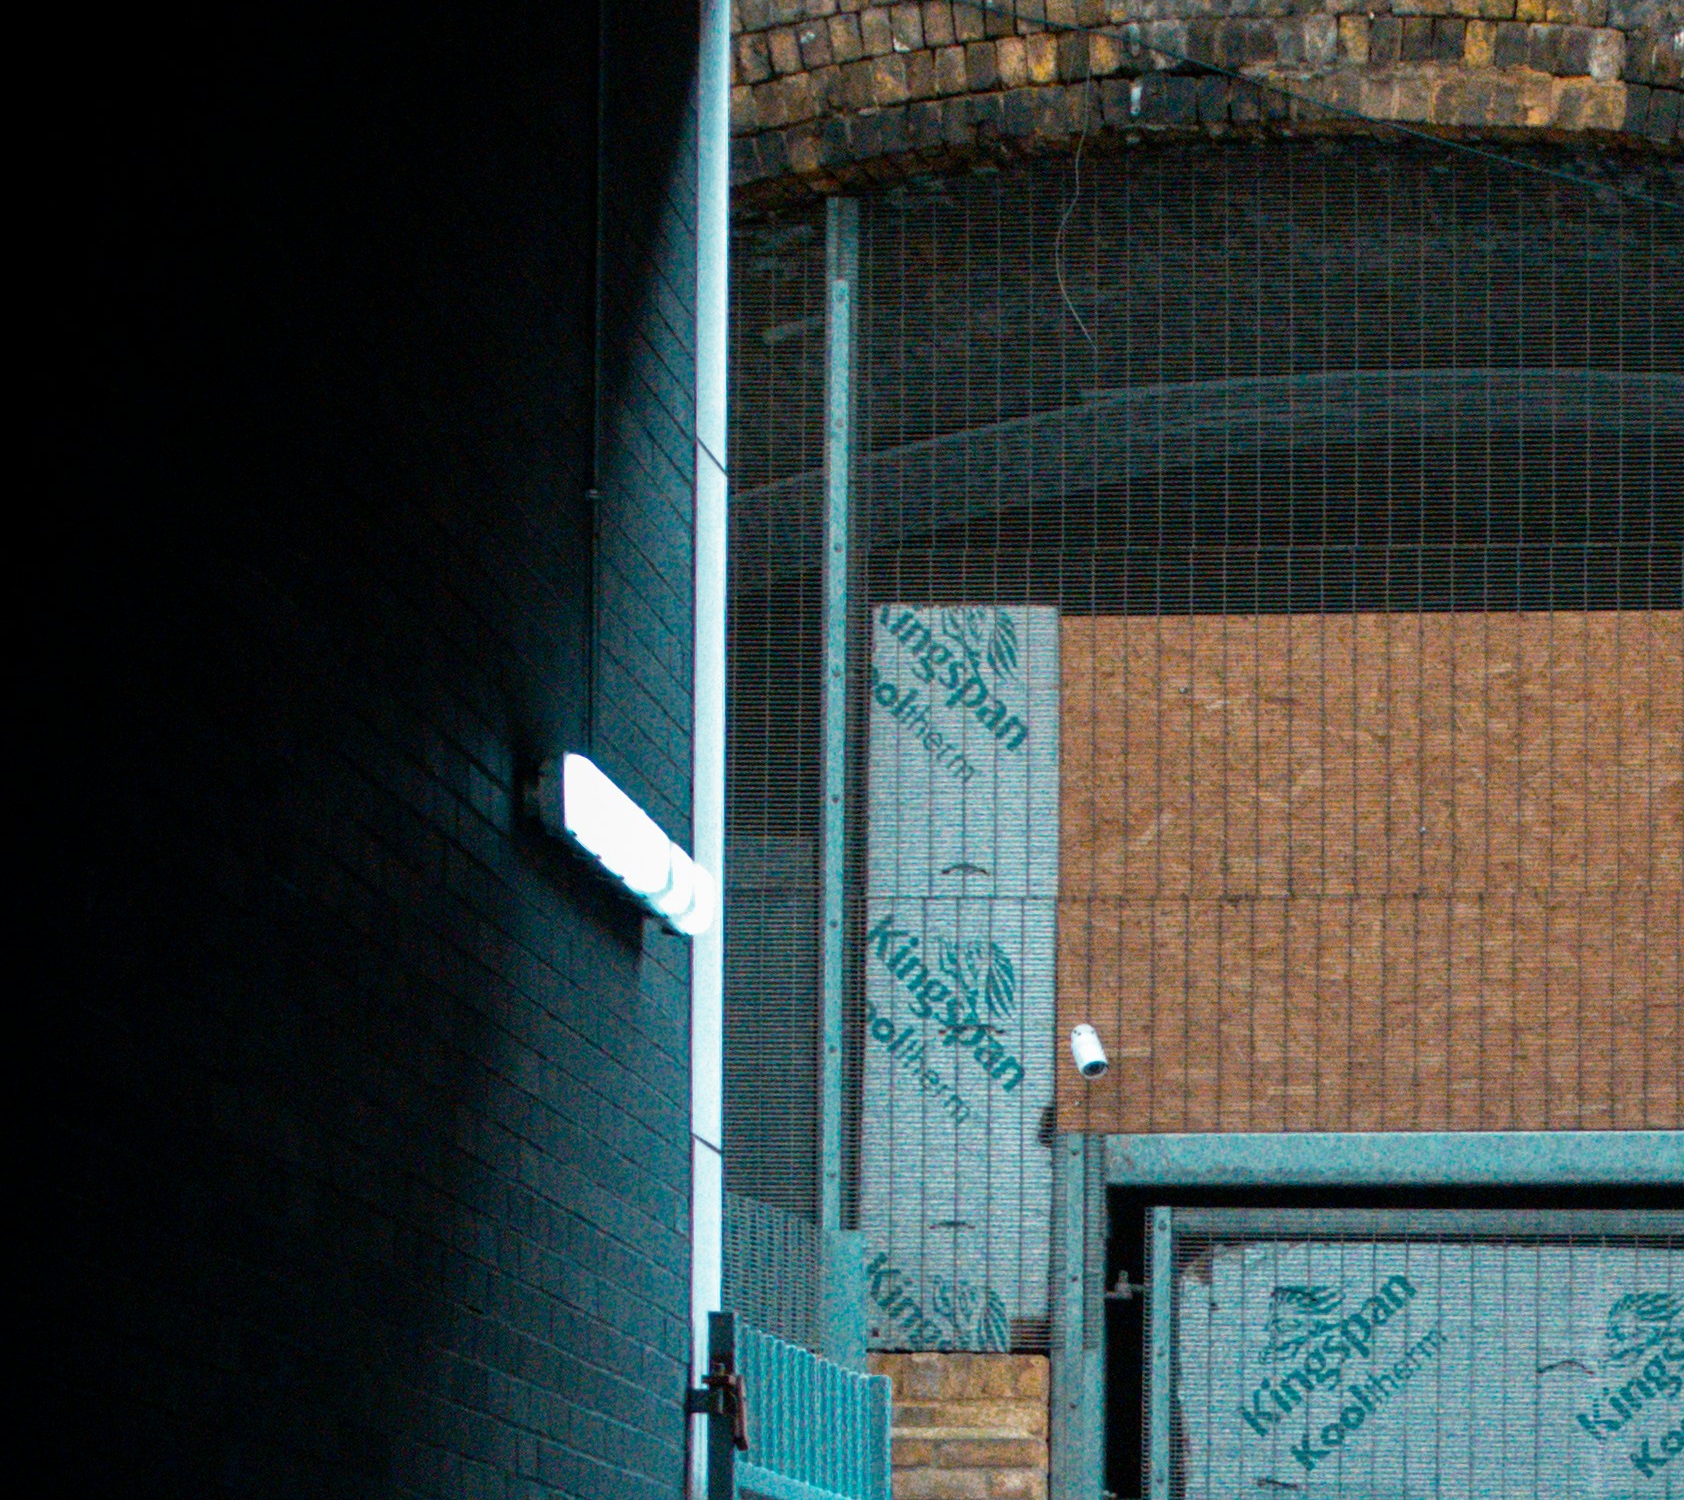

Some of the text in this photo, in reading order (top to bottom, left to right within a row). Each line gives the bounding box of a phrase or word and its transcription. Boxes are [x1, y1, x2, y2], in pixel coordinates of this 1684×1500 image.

[878, 605, 1029, 750] ingspan
[867, 915, 1024, 1091] Kingspan
[1239, 1275, 1417, 1437] Kingspan
[1292, 1328, 1448, 1471] Kooltherm
